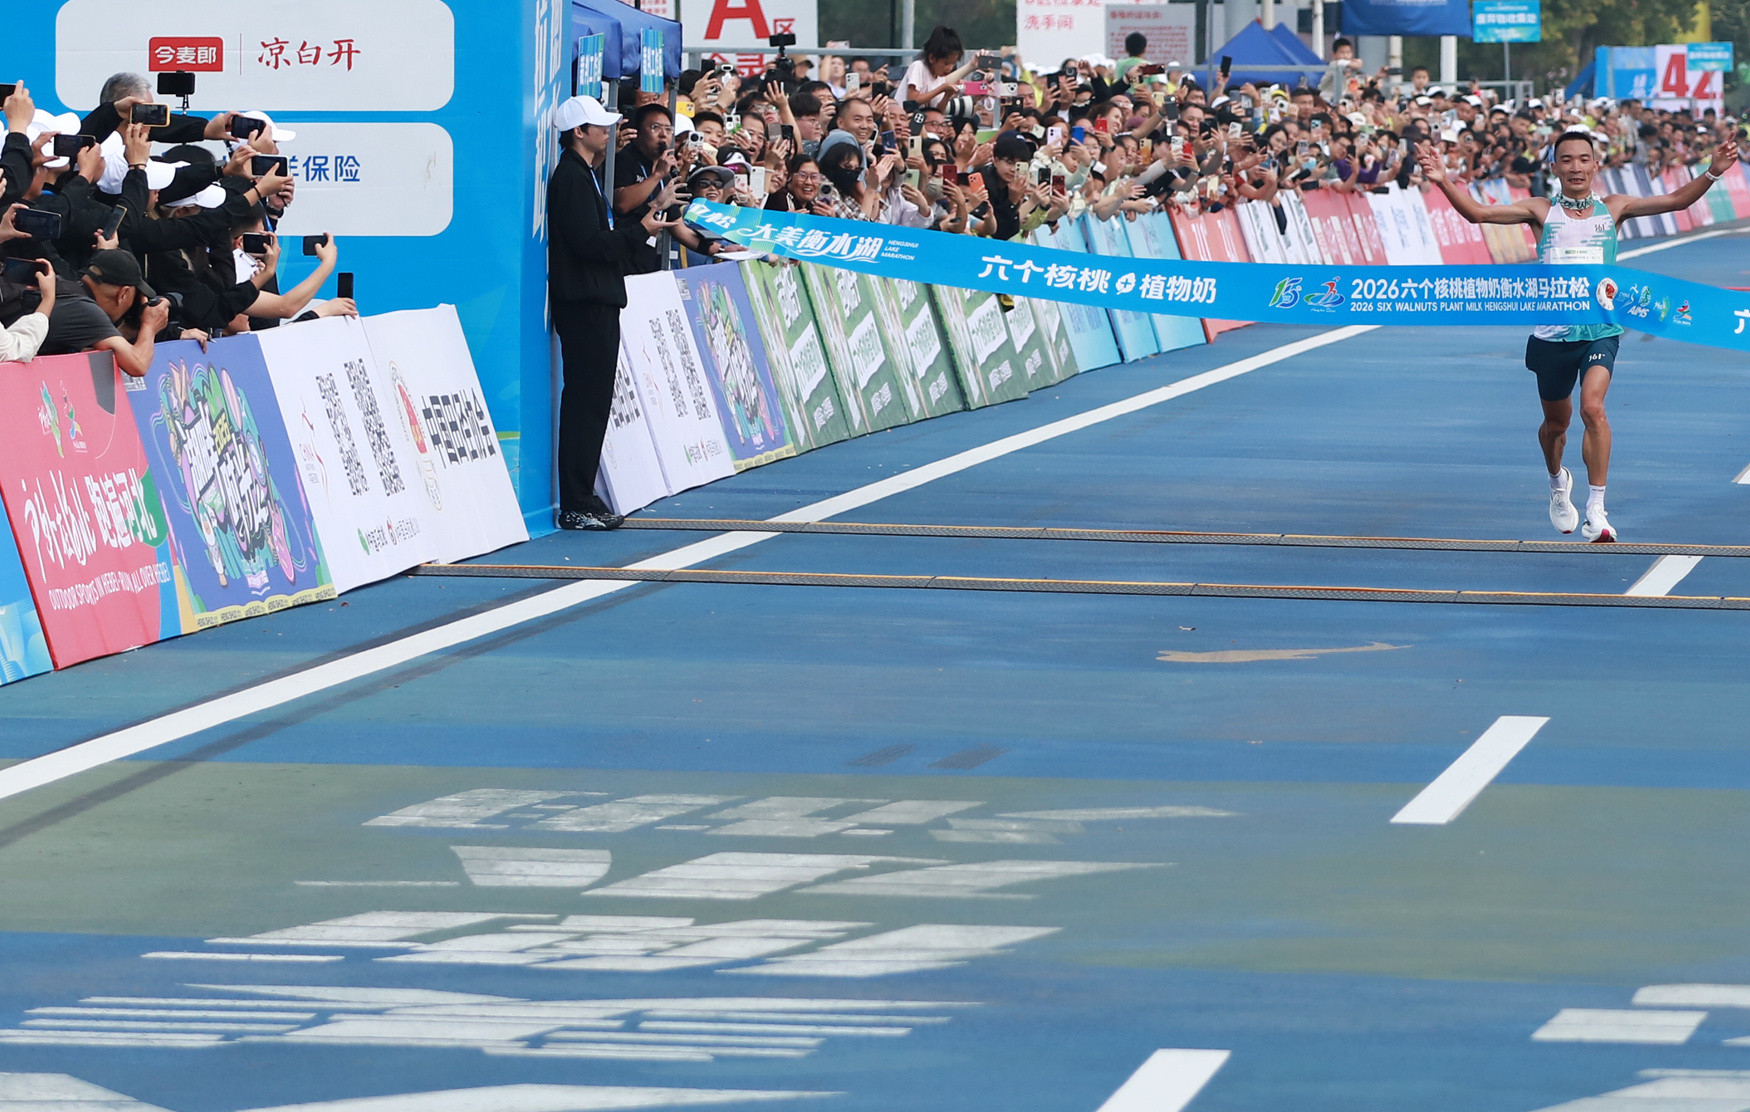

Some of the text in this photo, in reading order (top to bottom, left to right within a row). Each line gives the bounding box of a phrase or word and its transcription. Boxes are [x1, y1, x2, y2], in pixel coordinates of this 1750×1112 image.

[154, 46, 217, 65] 今麦郎
[257, 37, 361, 72] 凉白开
[288, 155, 361, 183] 保险
[738, 222, 884, 263] 大美衡水湖
[880, 252, 915, 261] MARATHON
[887, 239, 919, 248] HENGSHUI
[978, 254, 1217, 305] 六个核桃 植物奶
[1351, 276, 1590, 300] 2026六个核桃植物奶衡水湖马拉松
[1350, 300, 1590, 312] 2026 SIX WALNUTS PLANT MILK HENGSHUI LAKE MARATHON
[1627, 305, 1650, 318] AIMS
[422, 388, 497, 468] 中国田径协会
[21, 468, 158, 585] 户外在河北 跑遍河北
[49, 586, 79, 611] OUTDOOR
[75, 581, 100, 605] SPORTS
[154, 561, 171, 584] HEBEI
